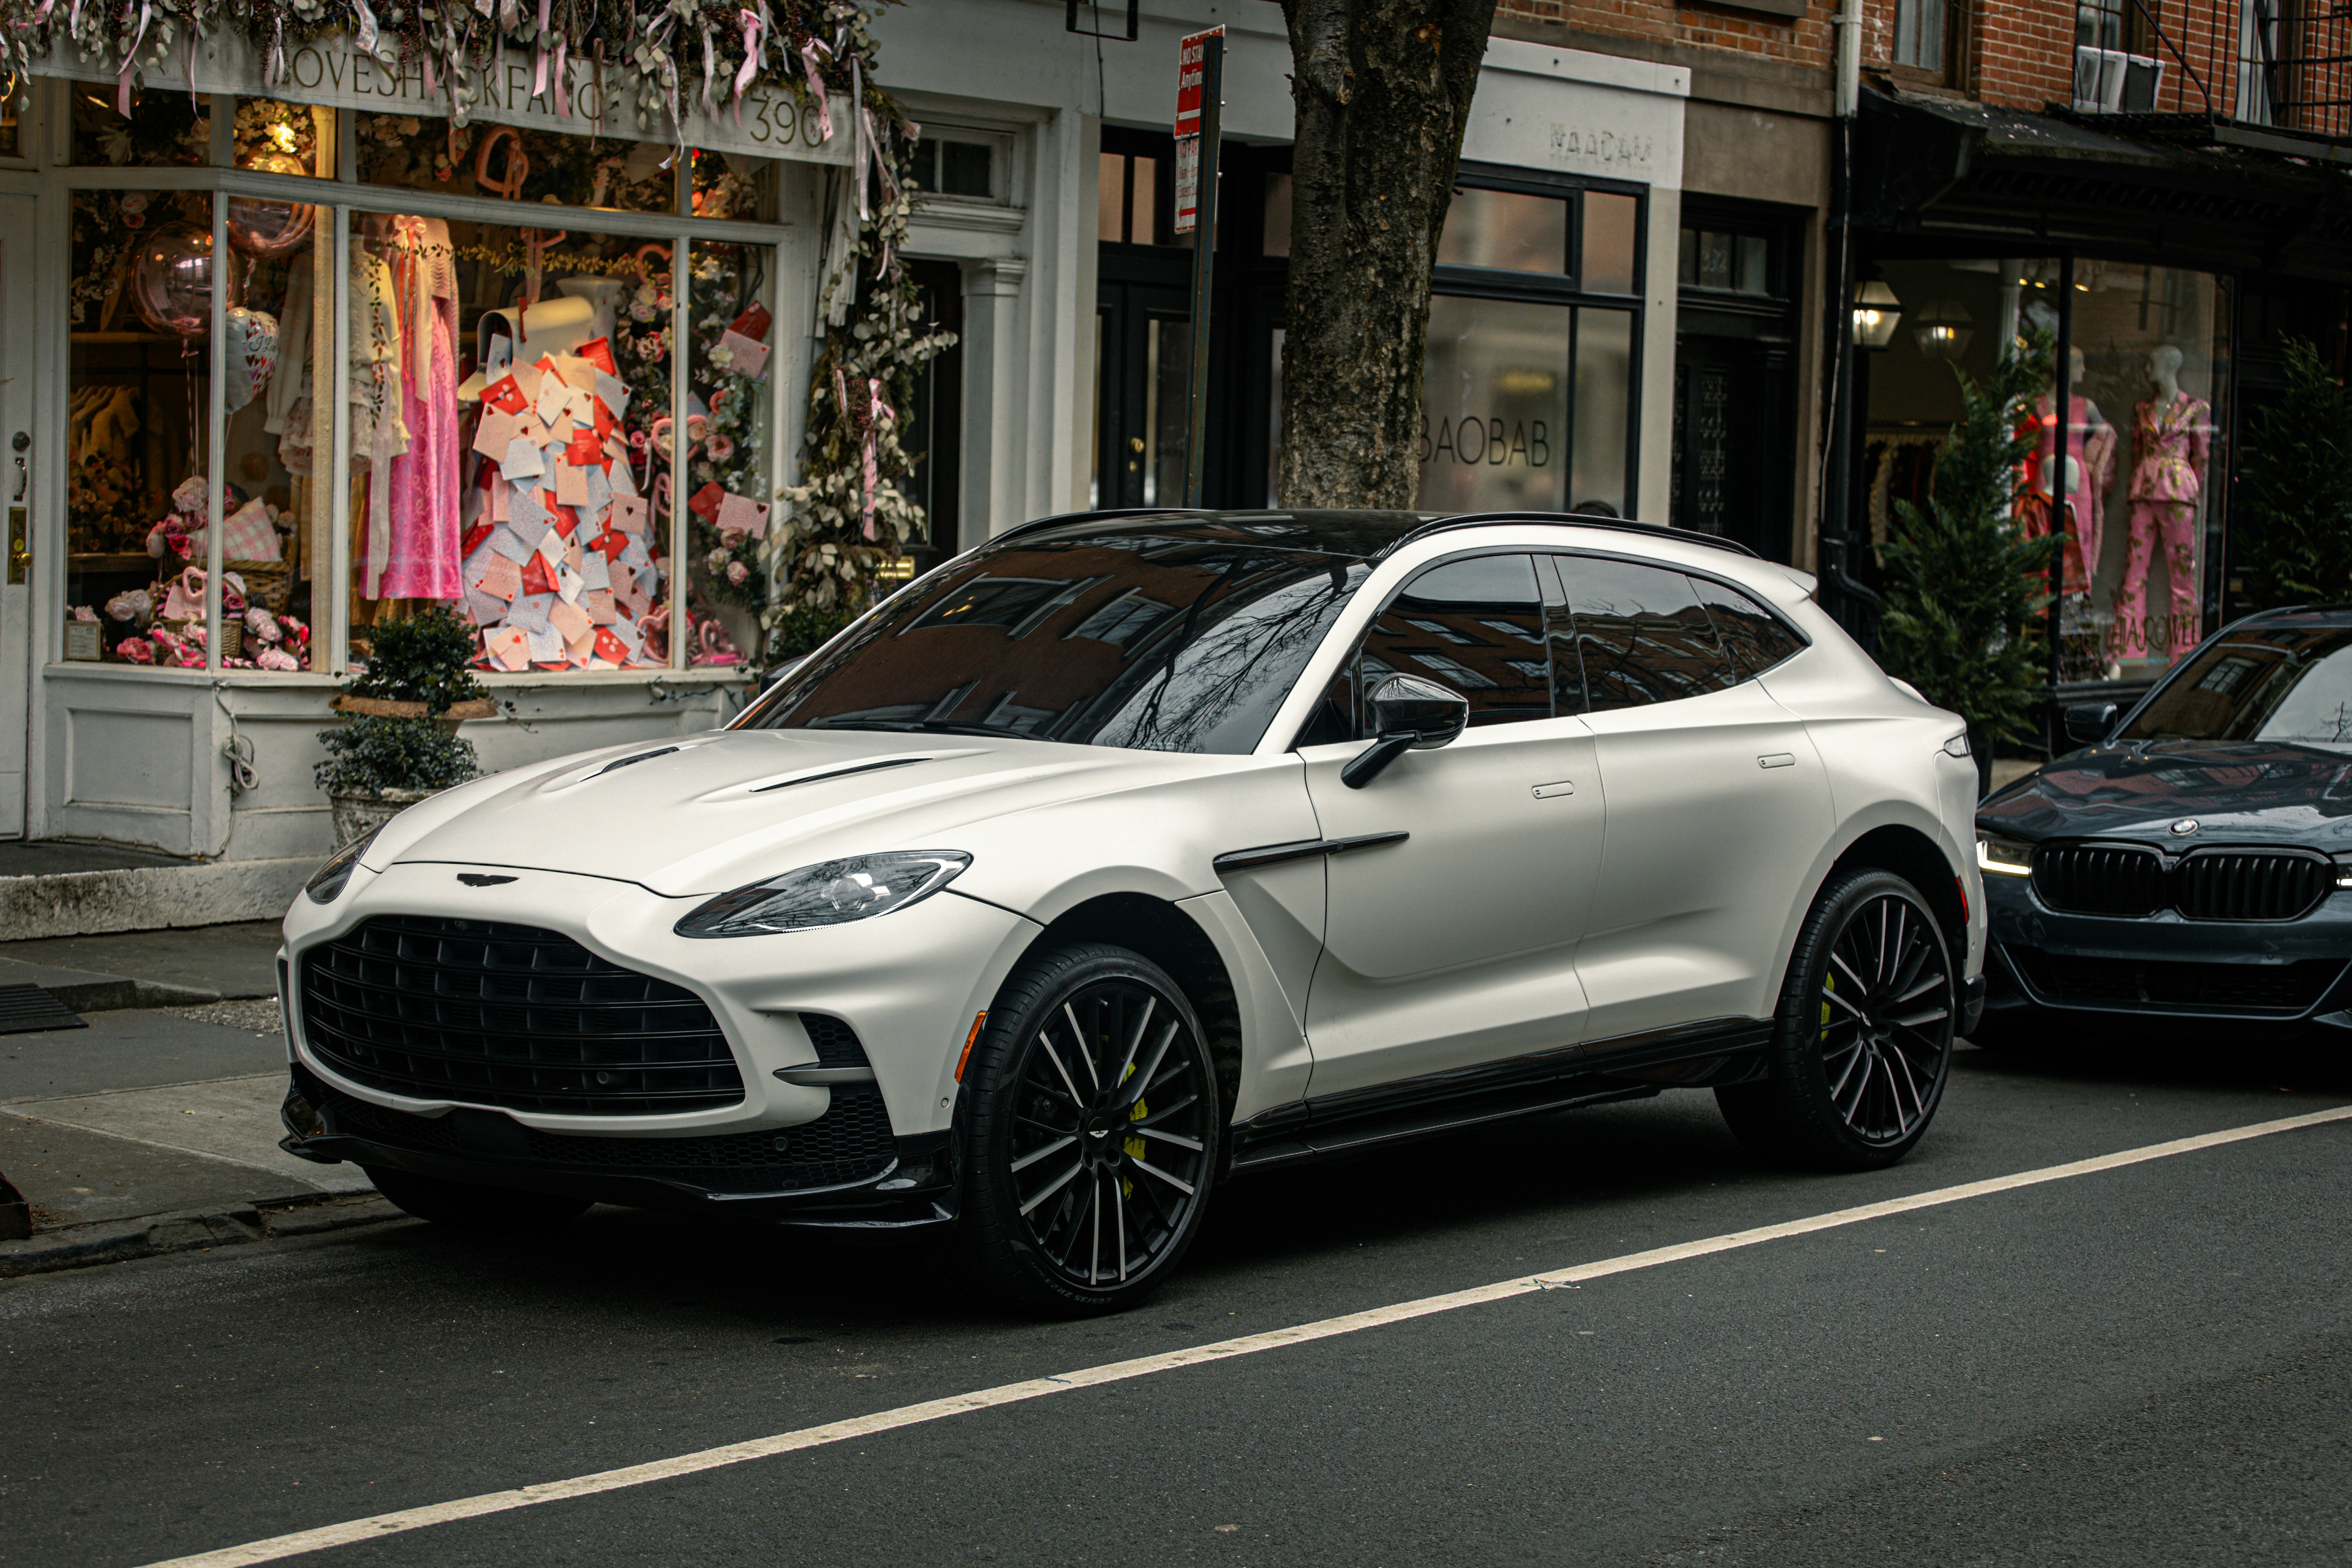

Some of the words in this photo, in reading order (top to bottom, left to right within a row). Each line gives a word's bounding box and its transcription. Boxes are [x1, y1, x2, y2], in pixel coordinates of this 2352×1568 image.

[1182, 47, 1191, 66] NO
[750, 95, 824, 147] 390
[1419, 415, 1549, 467] BAOBAB
